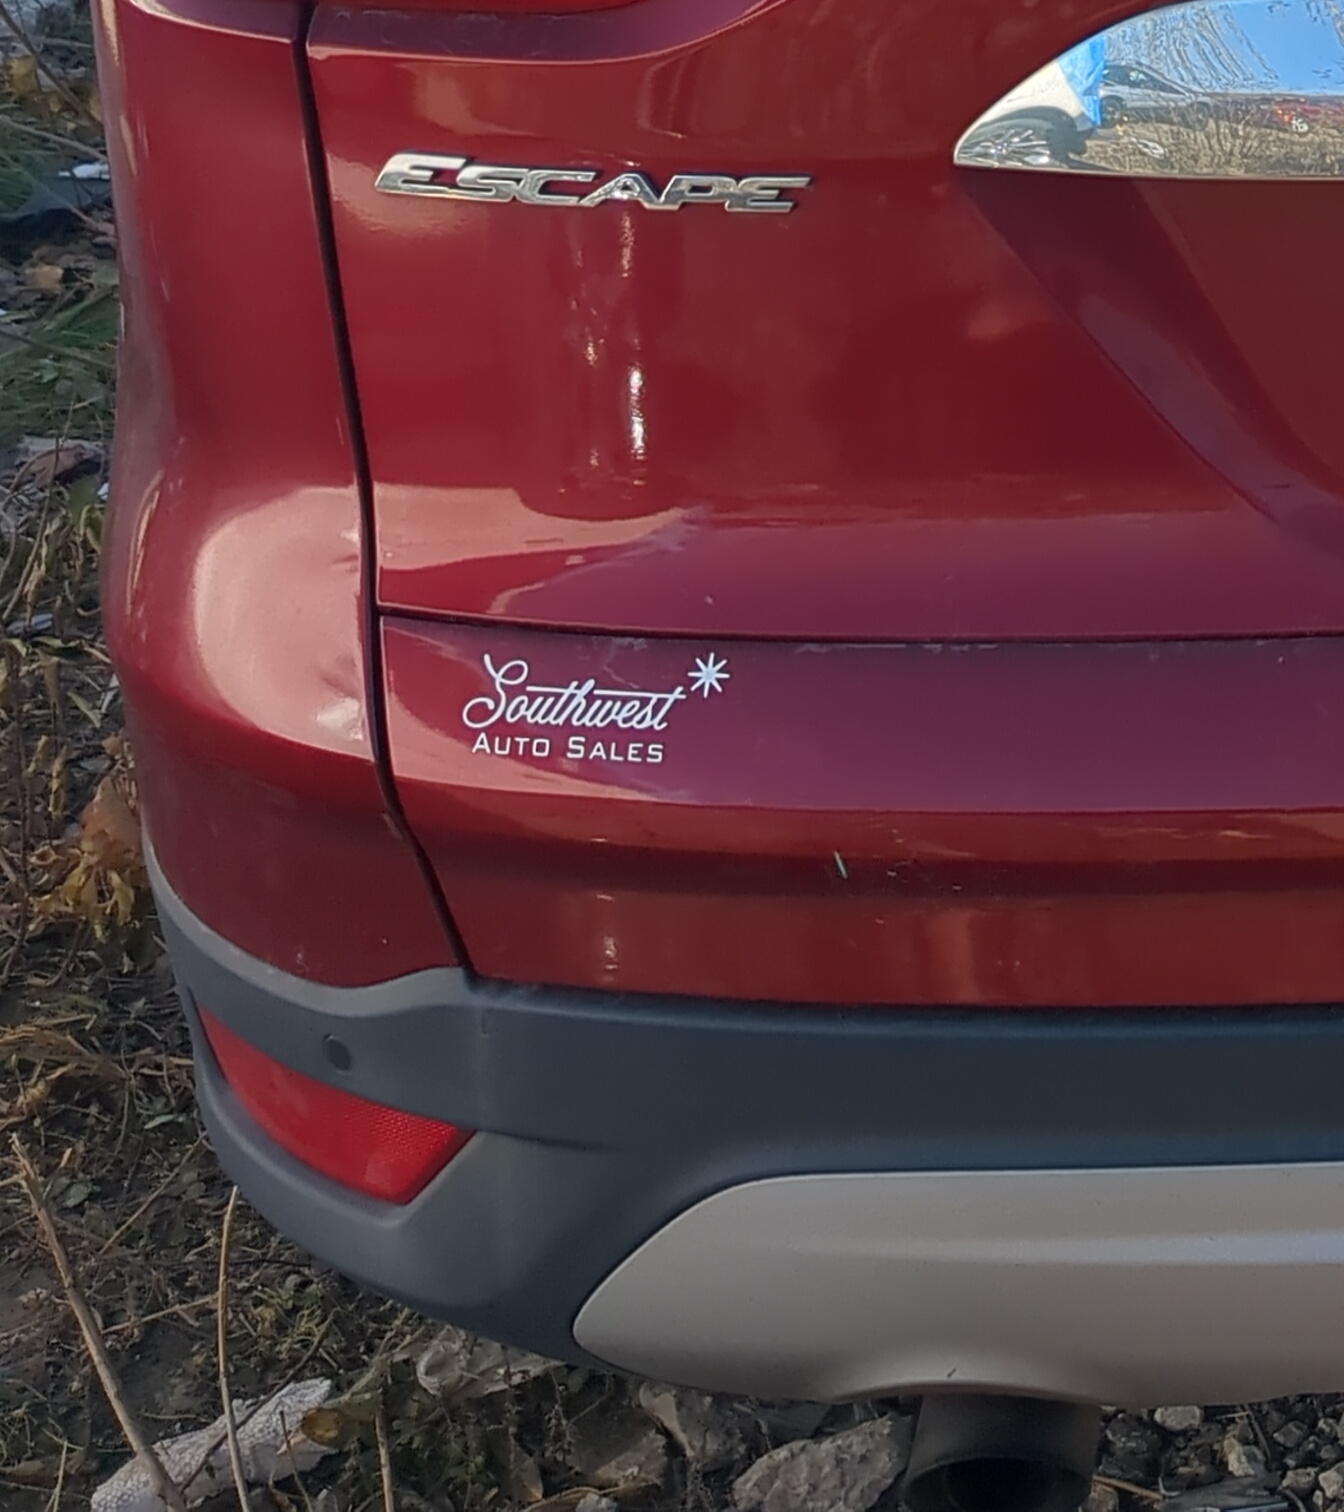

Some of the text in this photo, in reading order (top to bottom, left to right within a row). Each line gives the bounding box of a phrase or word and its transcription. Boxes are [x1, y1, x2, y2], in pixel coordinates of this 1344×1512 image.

[374, 151, 812, 212] ESCAPE
[462, 652, 687, 731] Southwest
[472, 732, 664, 764] AUTO SALES
